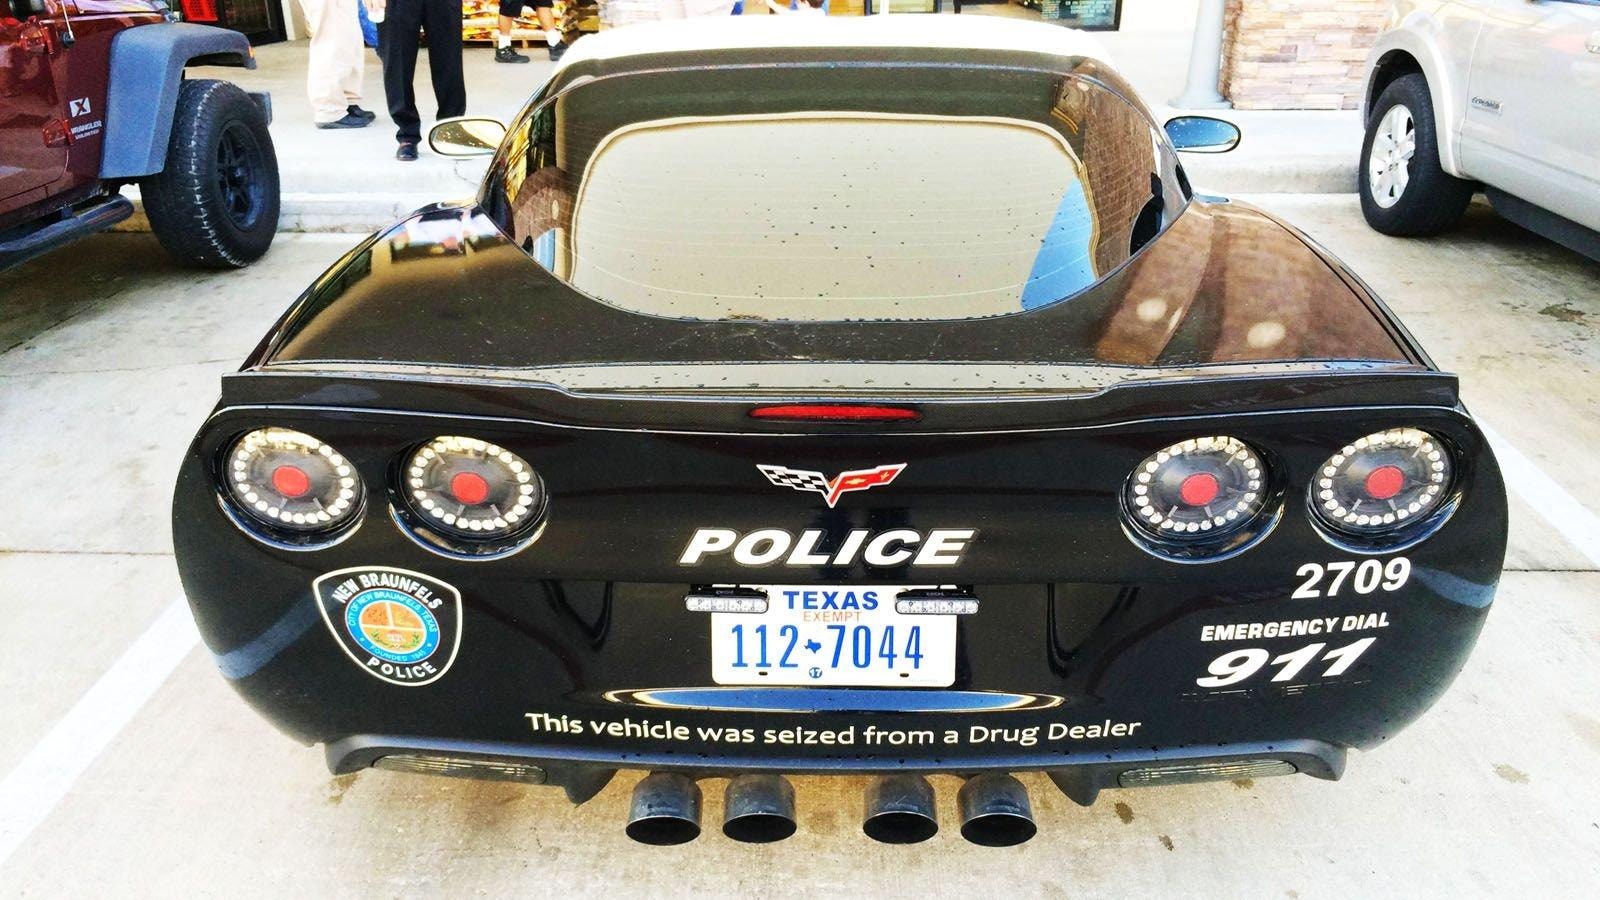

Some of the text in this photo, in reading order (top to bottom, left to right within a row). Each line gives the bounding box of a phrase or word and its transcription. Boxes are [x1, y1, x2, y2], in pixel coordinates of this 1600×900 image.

[678, 529, 975, 567] POLICE
[332, 573, 442, 608] NEW BRAUNFELS
[1291, 557, 1411, 599] 2709
[783, 591, 878, 610] TEXAS
[803, 611, 862, 622] EXEMPT
[1201, 611, 1390, 642] EMERGENCY DIAL
[732, 624, 923, 669] 112 7044
[1196, 637, 1377, 688] 911
[367, 656, 437, 679] POLICE
[525, 713, 1141, 747] This vehicle was seized from a Drug Dealer
